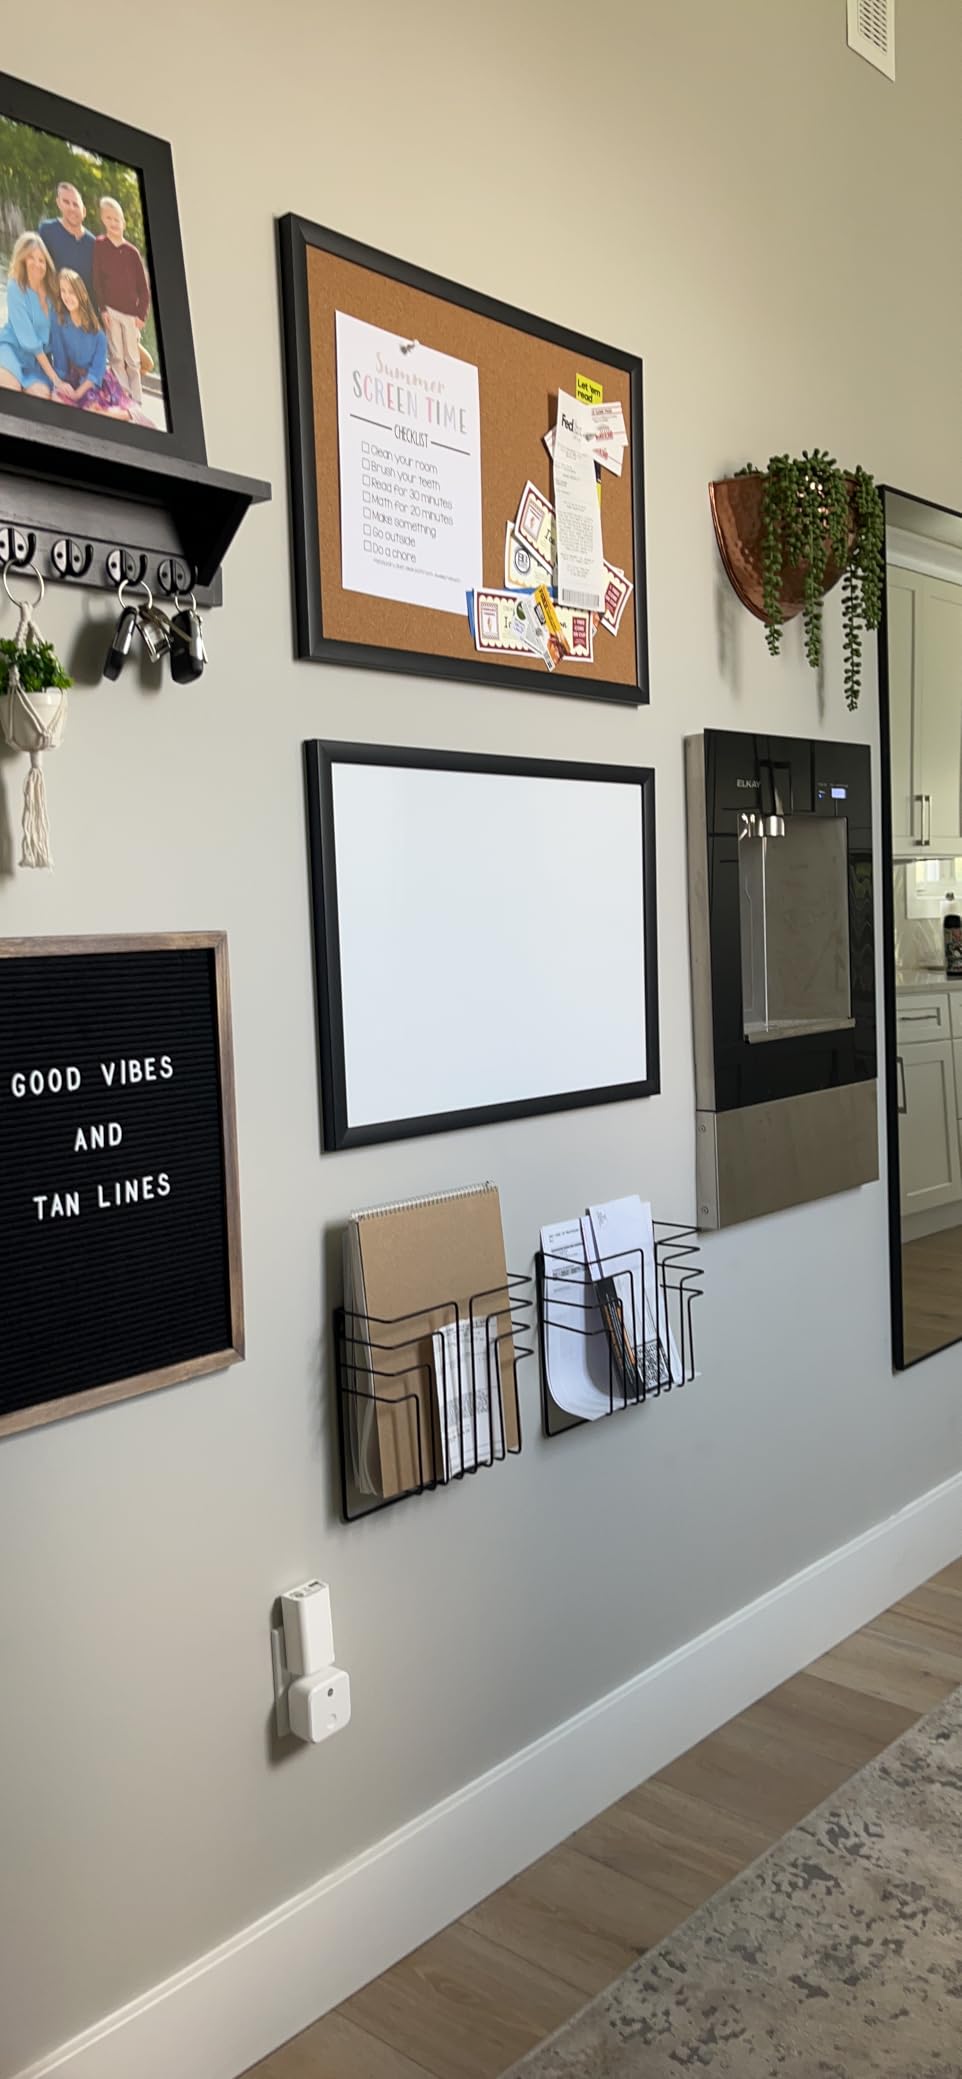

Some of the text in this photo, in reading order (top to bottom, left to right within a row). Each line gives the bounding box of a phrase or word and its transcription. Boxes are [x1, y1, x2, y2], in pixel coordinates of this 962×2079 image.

[577, 378, 588, 391] Let
[352, 369, 468, 434] SCREEN TIME
[394, 423, 429, 448] CHECKLIST
[371, 444, 438, 475] Clean your room
[371, 460, 441, 491] Brush your teeth
[371, 477, 453, 510] Read for 30 minutes
[371, 493, 454, 526] Math for 20 minutes
[372, 510, 437, 538] Make something
[372, 527, 416, 547] Go outside
[372, 542, 417, 564] Do a chore
[736, 779, 761, 789] ELKAY
[11, 1055, 174, 1098] GOOD VIBES
[73, 1122, 123, 1152] AND
[32, 1172, 171, 1221] TAN LINES
